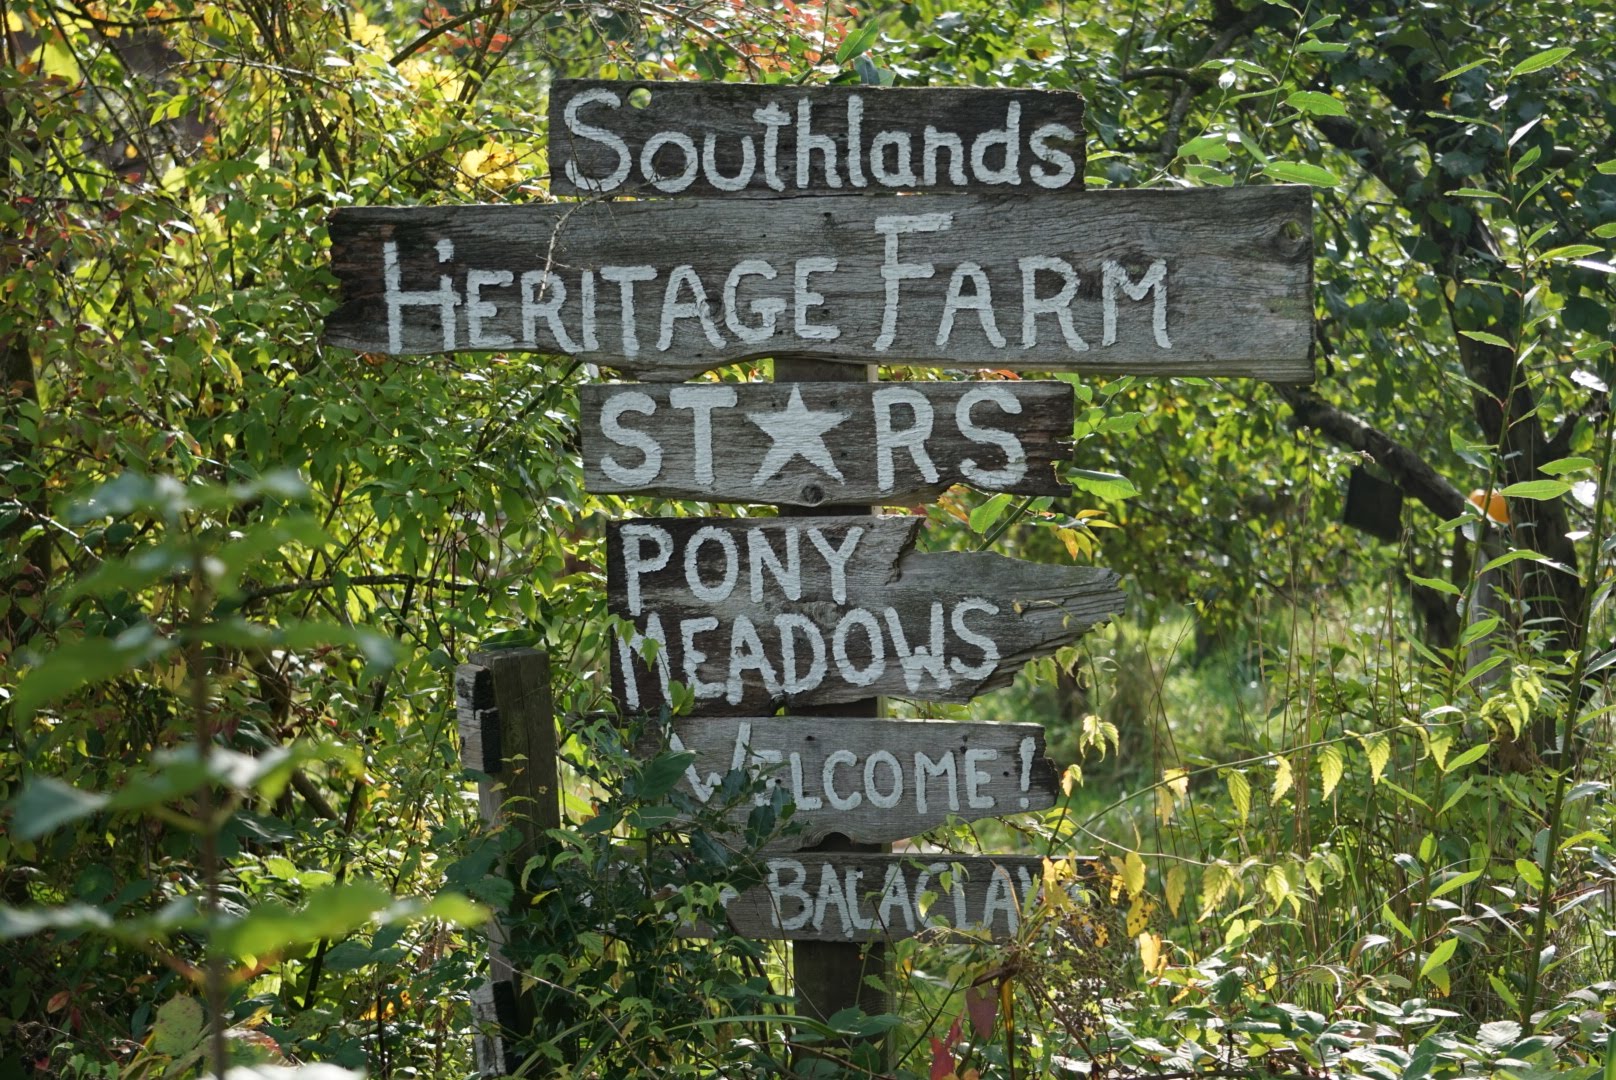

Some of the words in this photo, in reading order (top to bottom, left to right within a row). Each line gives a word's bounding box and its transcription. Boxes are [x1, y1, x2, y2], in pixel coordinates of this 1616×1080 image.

[563, 87, 1076, 193] Southlands
[382, 238, 841, 360] HERITAGE
[873, 212, 1173, 352] FARM
[620, 523, 865, 617] PONY
[612, 597, 1000, 712] MEADOWS
